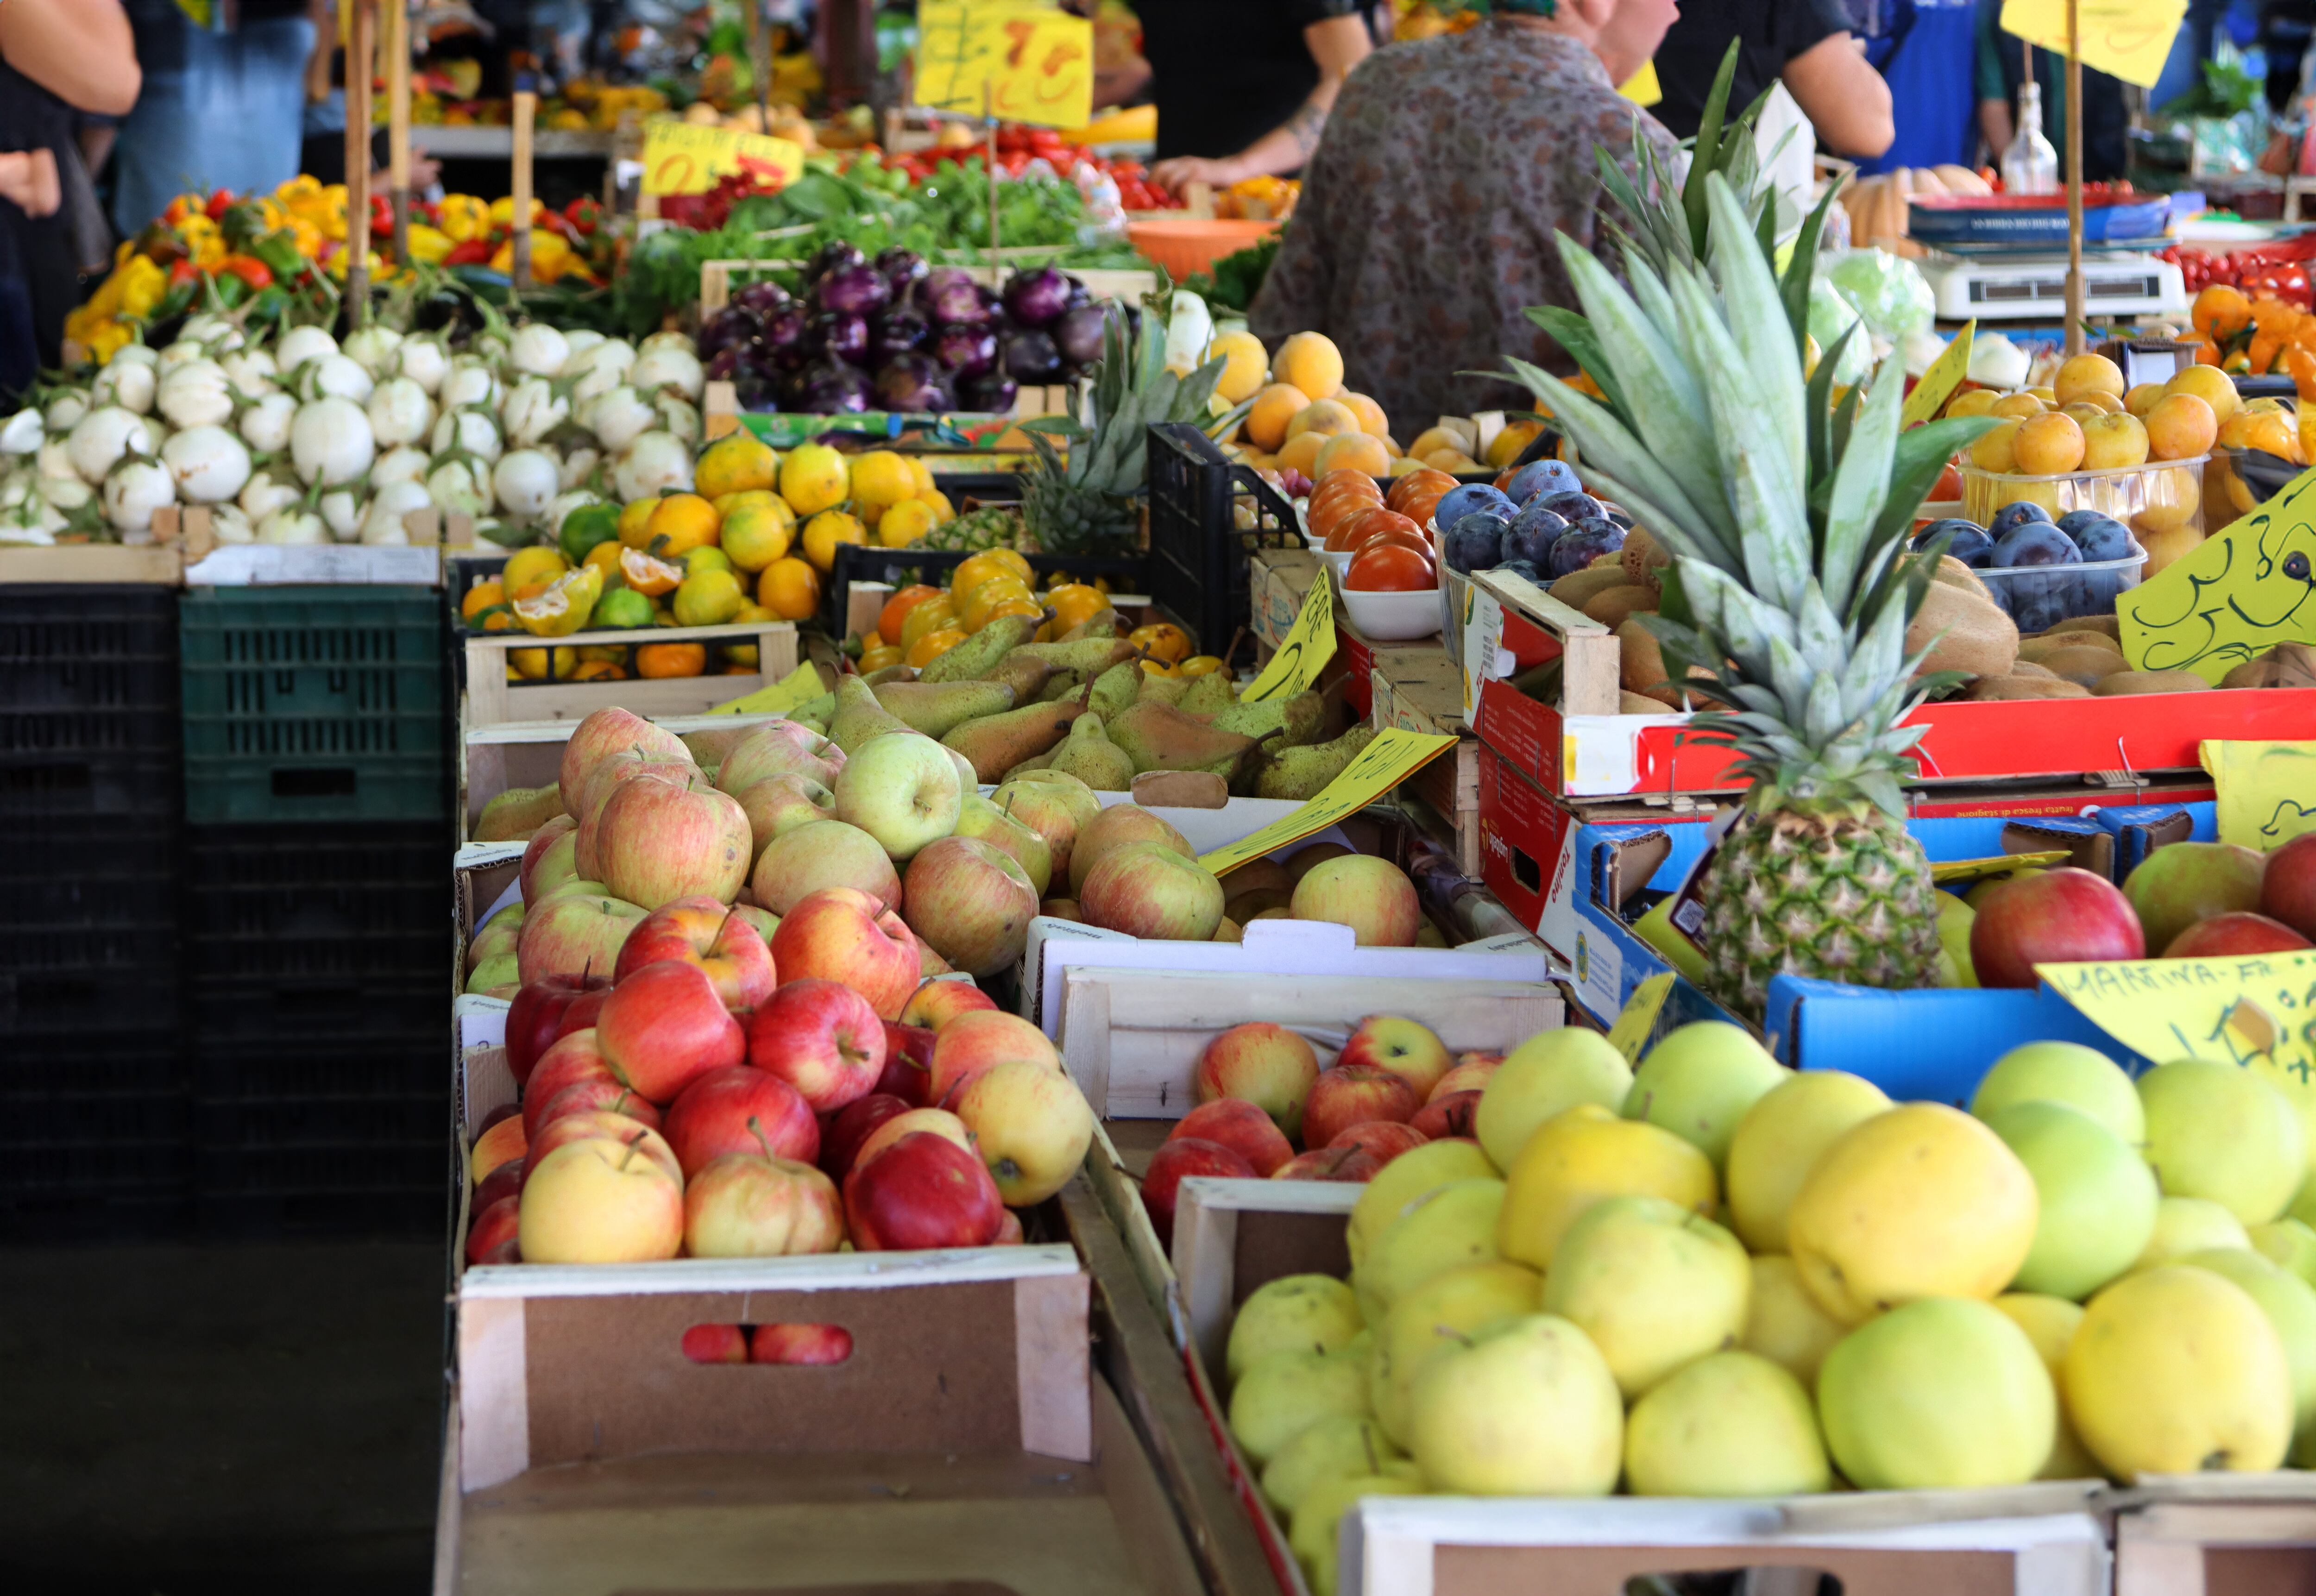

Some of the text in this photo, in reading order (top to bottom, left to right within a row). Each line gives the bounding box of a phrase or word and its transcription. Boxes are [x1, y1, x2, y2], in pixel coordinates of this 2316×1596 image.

[2014, 807, 2042, 815] fresca
[2045, 805, 2074, 814] frutta
[1552, 845, 1571, 903] Tonino
